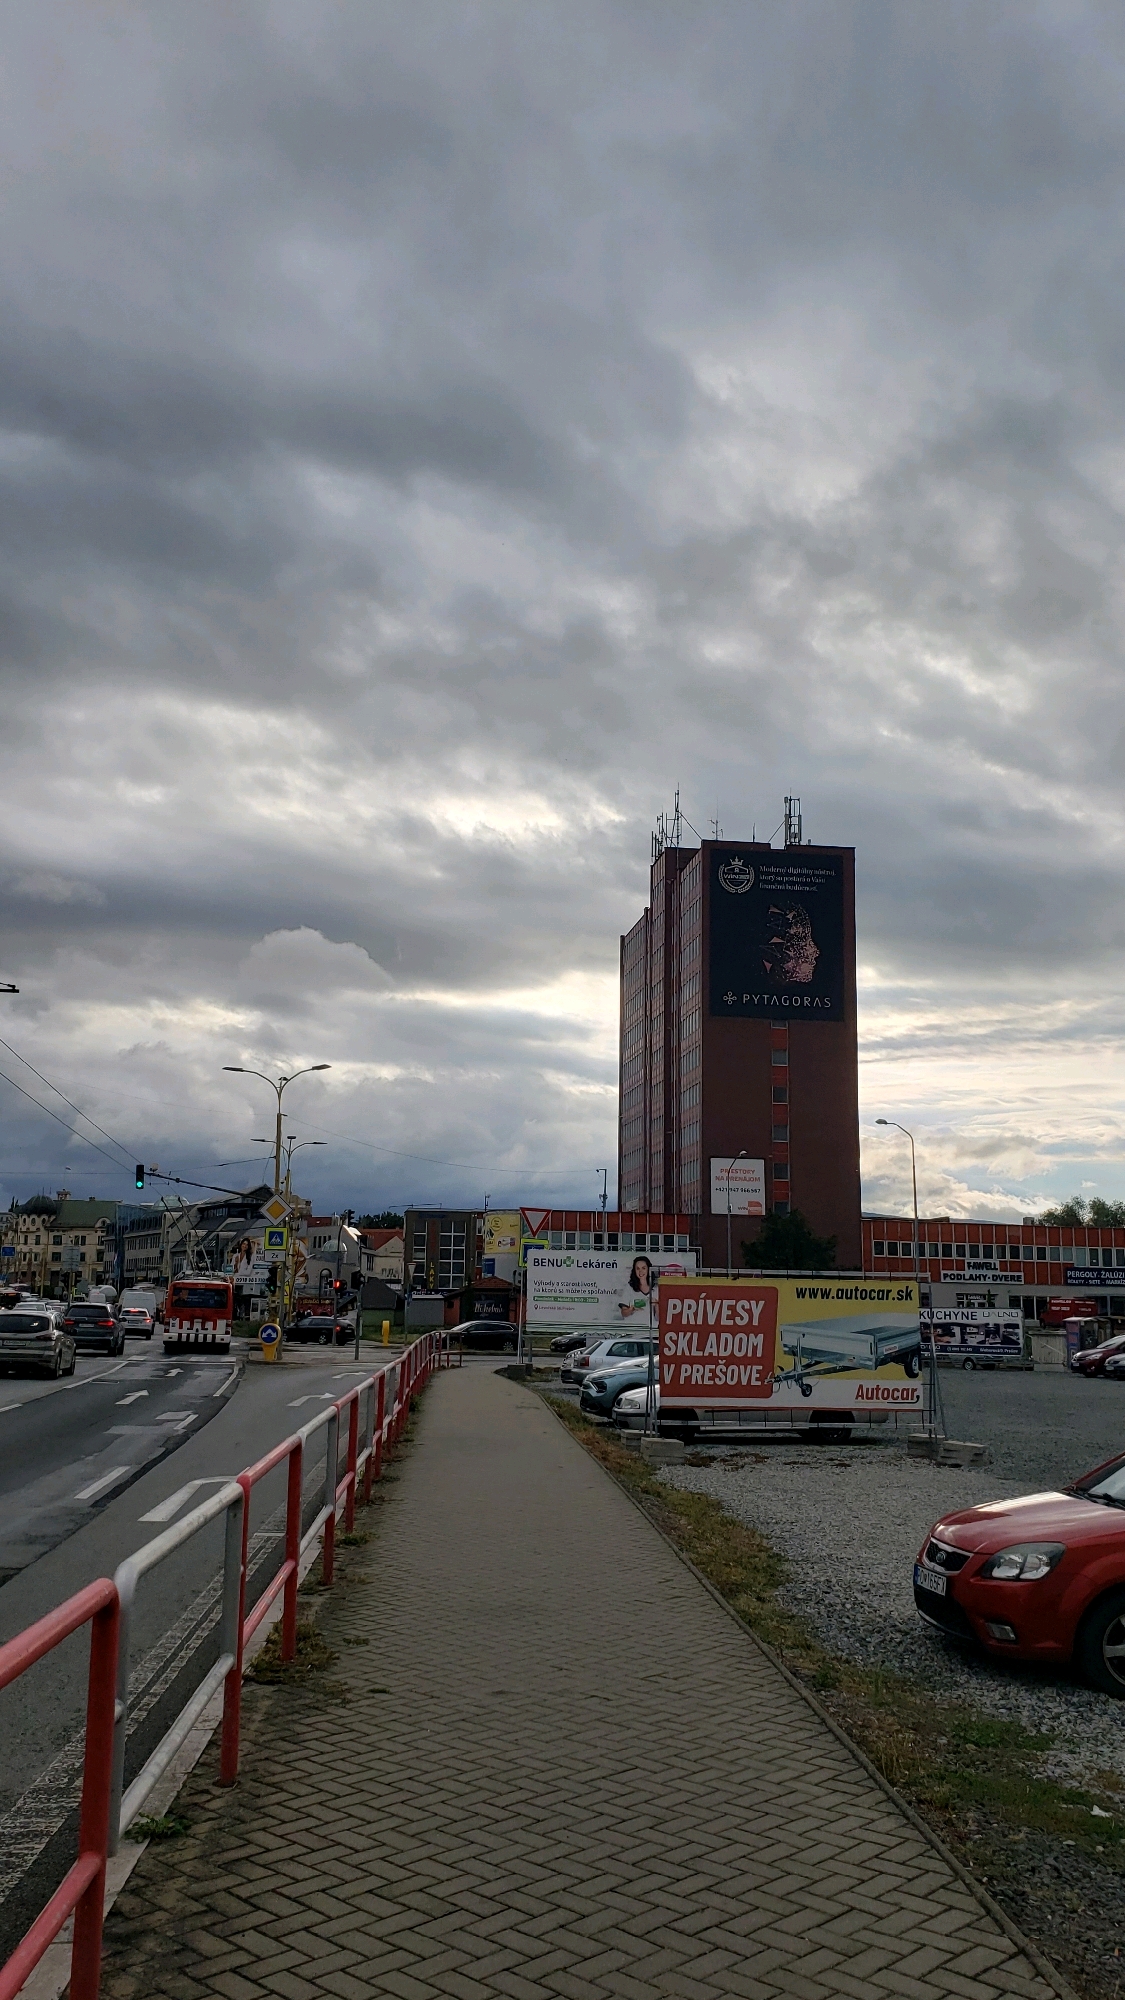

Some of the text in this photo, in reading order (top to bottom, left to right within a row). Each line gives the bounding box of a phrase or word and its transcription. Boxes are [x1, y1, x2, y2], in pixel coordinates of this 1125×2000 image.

[743, 993, 831, 1008] PYTAGORAS
[533, 1258, 618, 1268] BENU Lekáreň
[943, 1273, 1022, 1282] PODLAHY DVERE
[1067, 1270, 1098, 1278] PERGOLY
[795, 1285, 914, 1301] www.autocar.sk
[666, 1292, 765, 1326] PRÍVESY
[919, 1310, 978, 1321] KUCHYNE
[663, 1331, 764, 1358] SKLADOM
[663, 1359, 763, 1386] V PREŠOVE
[855, 1383, 918, 1401] Autocar
